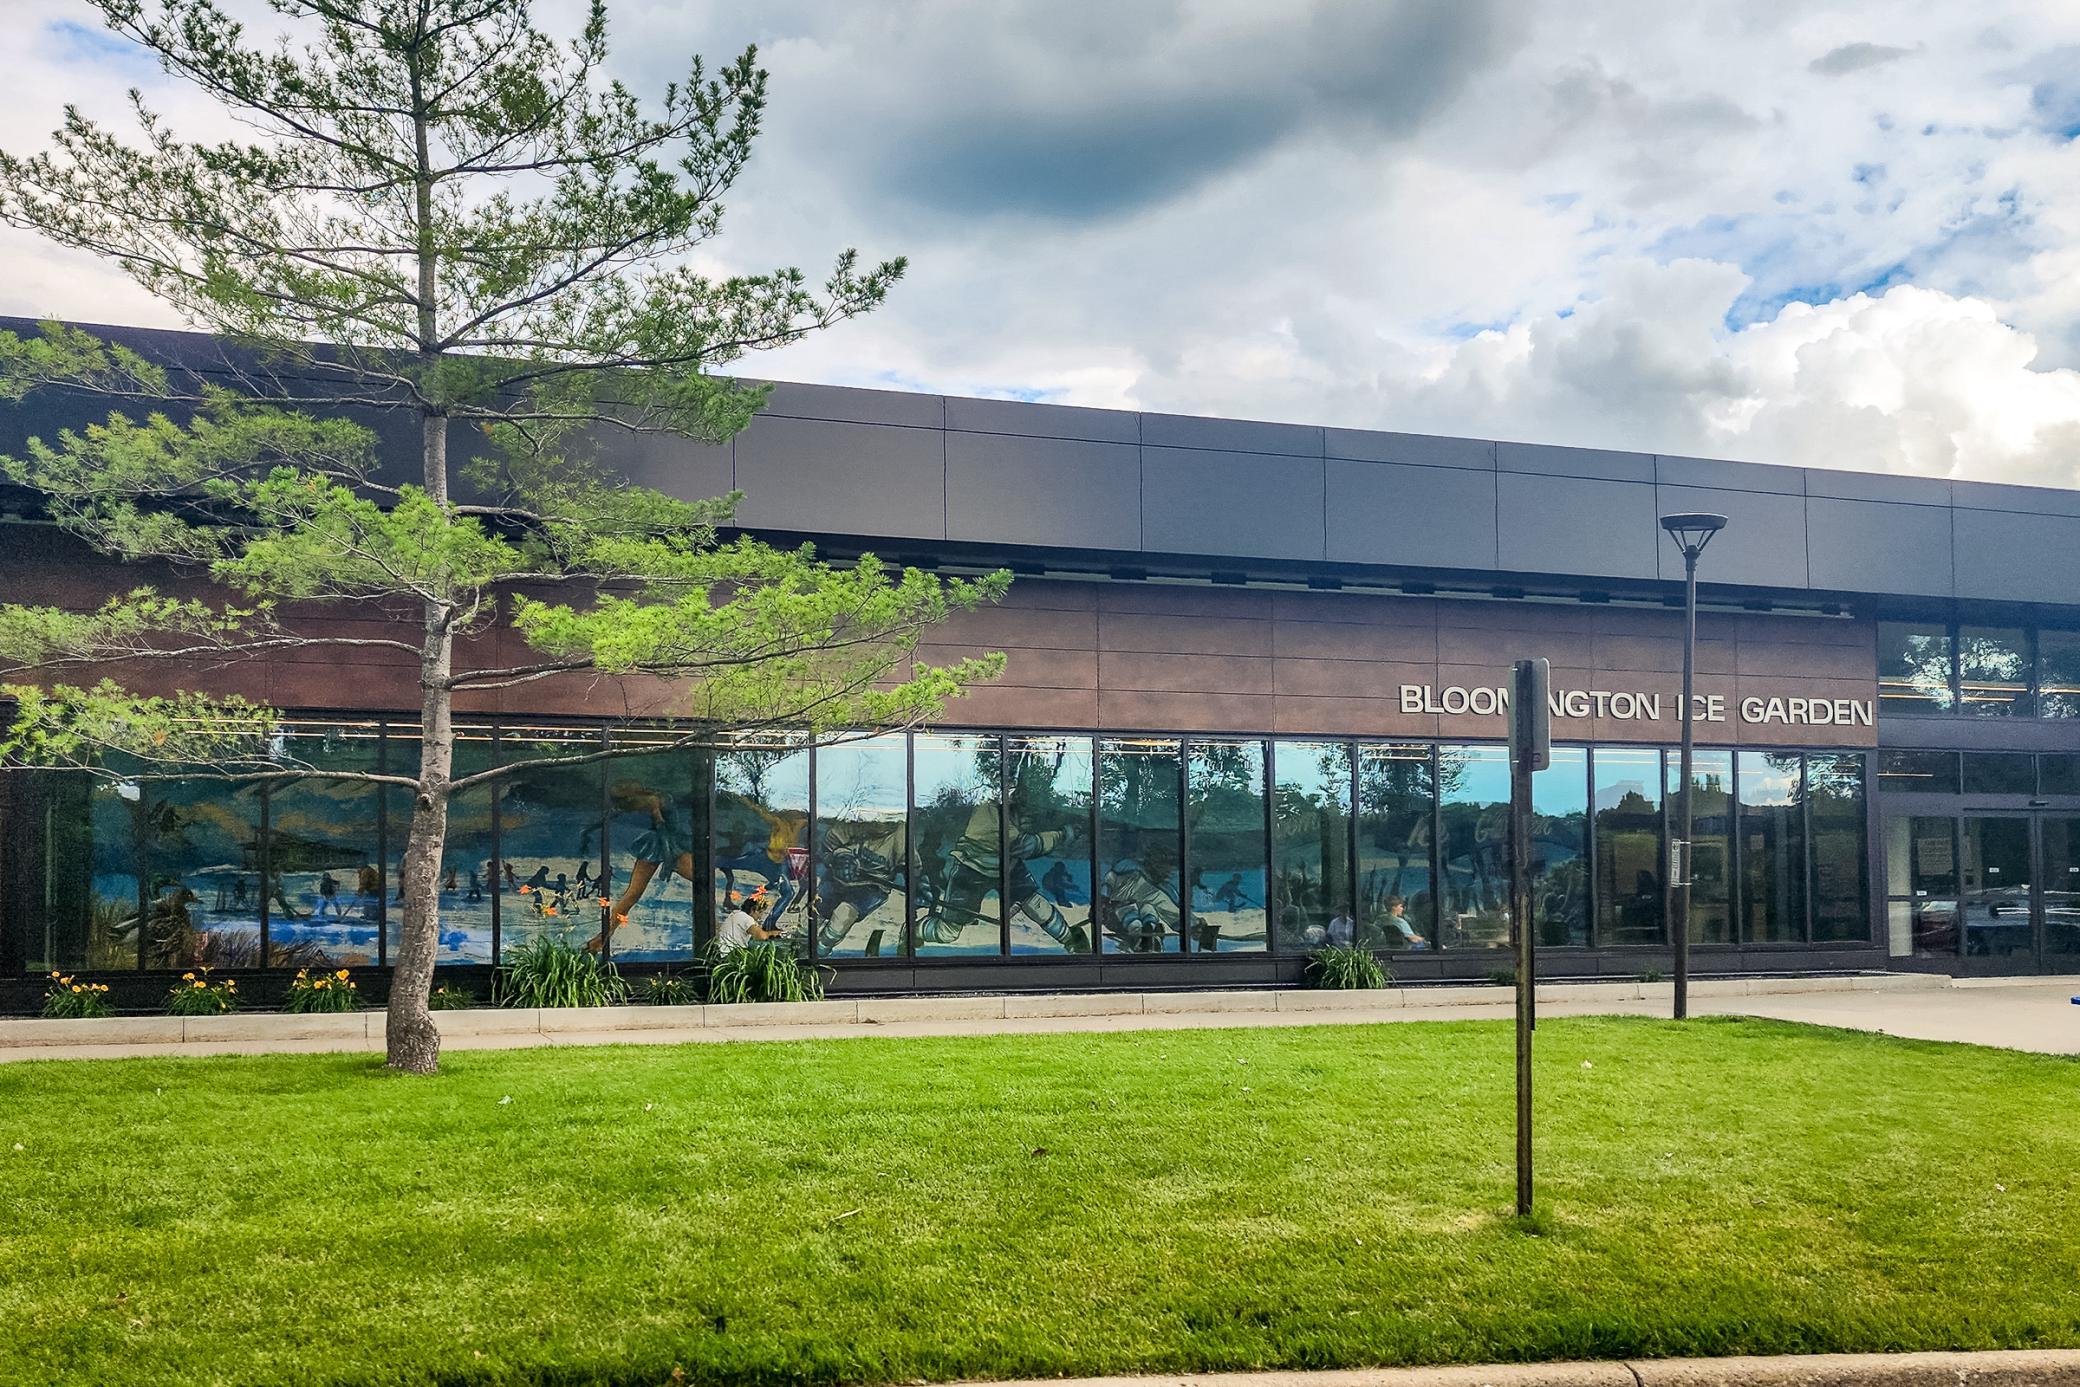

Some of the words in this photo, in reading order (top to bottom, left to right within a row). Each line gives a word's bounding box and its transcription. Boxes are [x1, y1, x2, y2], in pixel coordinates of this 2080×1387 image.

[1400, 684, 1660, 720] BLOONGTON
[1677, 694, 1726, 722] ICE
[1741, 696, 1873, 727] GARDEN
